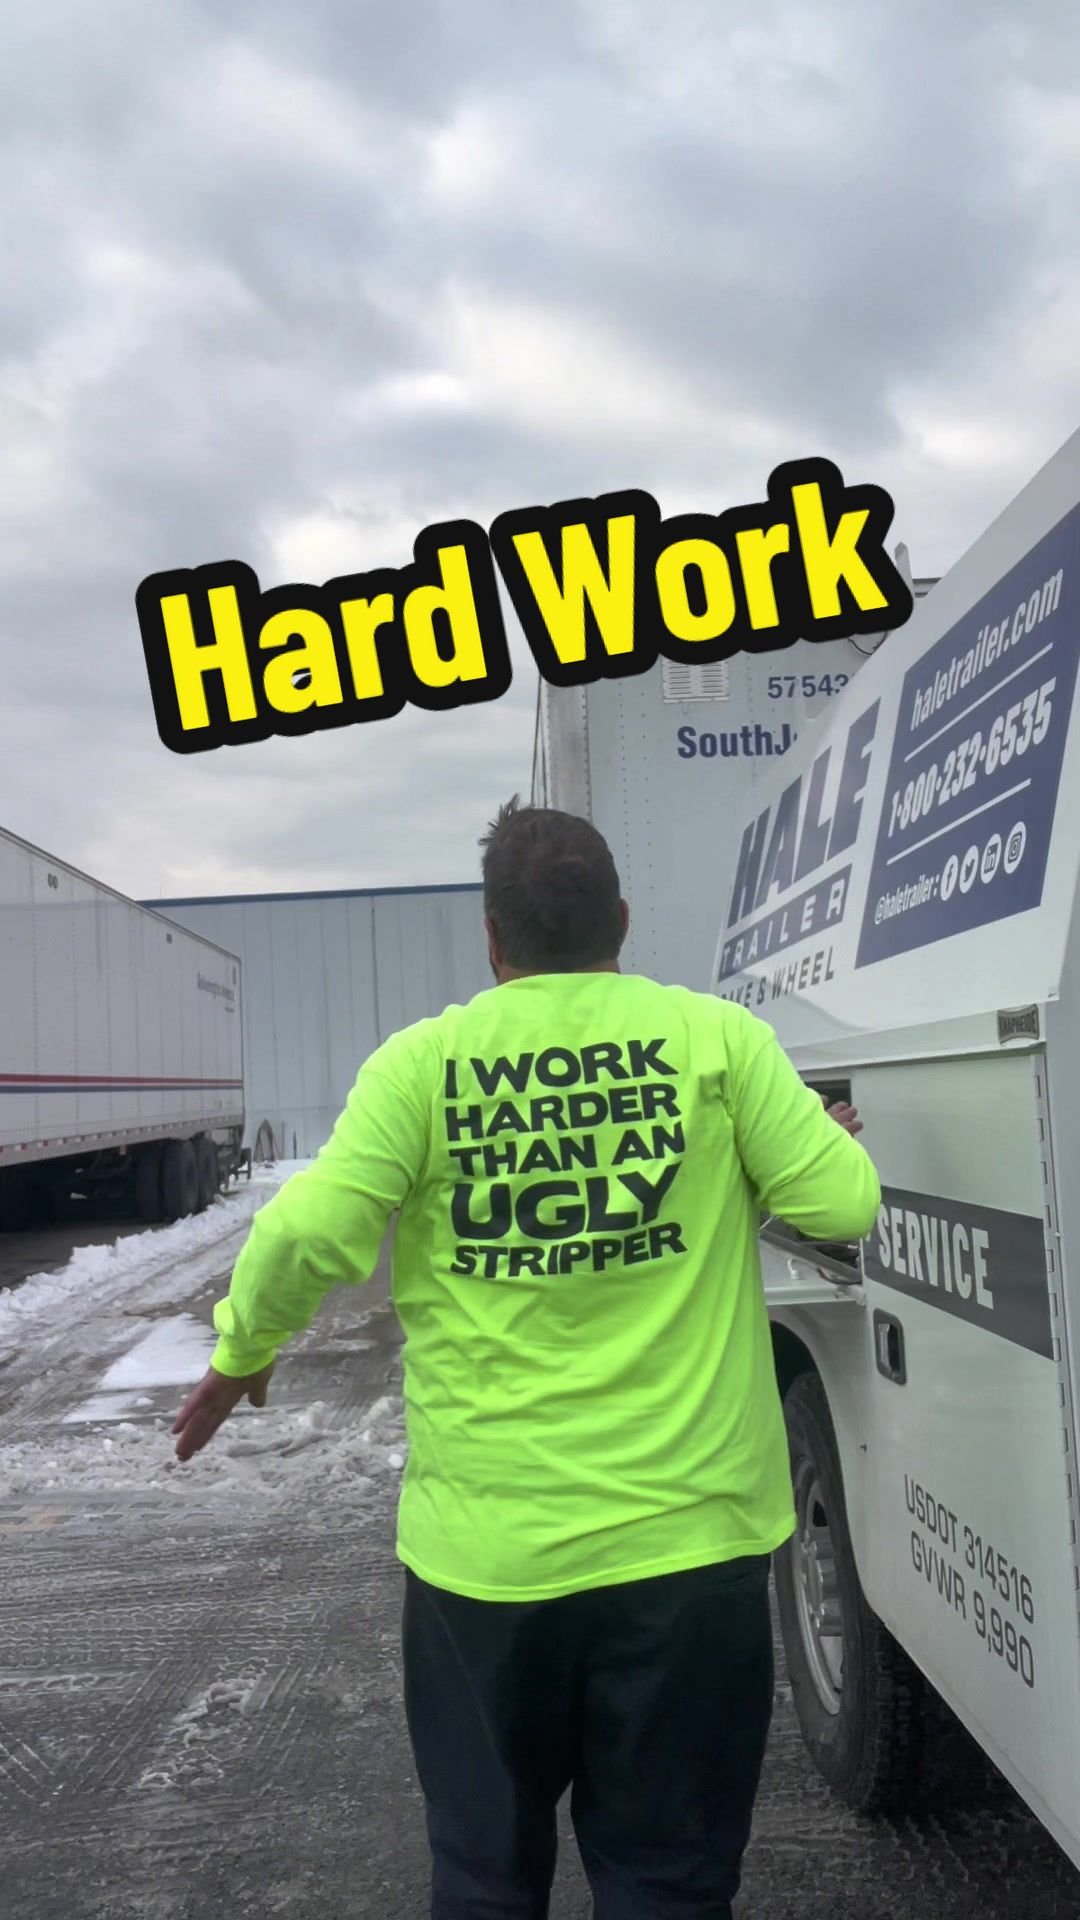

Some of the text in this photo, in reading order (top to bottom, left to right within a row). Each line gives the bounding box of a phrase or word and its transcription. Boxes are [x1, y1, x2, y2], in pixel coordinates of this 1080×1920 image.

[910, 568, 1064, 732] haletrailer.com
[767, 673, 856, 699] 57543
[677, 723, 798, 759] SouthJ
[727, 696, 882, 930] HALE
[722, 878, 846, 974] TRAILER
[772, 946, 834, 1000] WHEEL
[445, 1038, 679, 1099] I WORK
[445, 1083, 682, 1141] HARDER
[448, 1121, 686, 1176] THAN AN
[451, 1161, 682, 1240] UGLY
[450, 1222, 688, 1278] STRIPPER
[877, 1203, 994, 1310] SERVICE
[904, 1474, 1034, 1624] USDOT 314516
[911, 1531, 1034, 1688] GVWR 9,990
